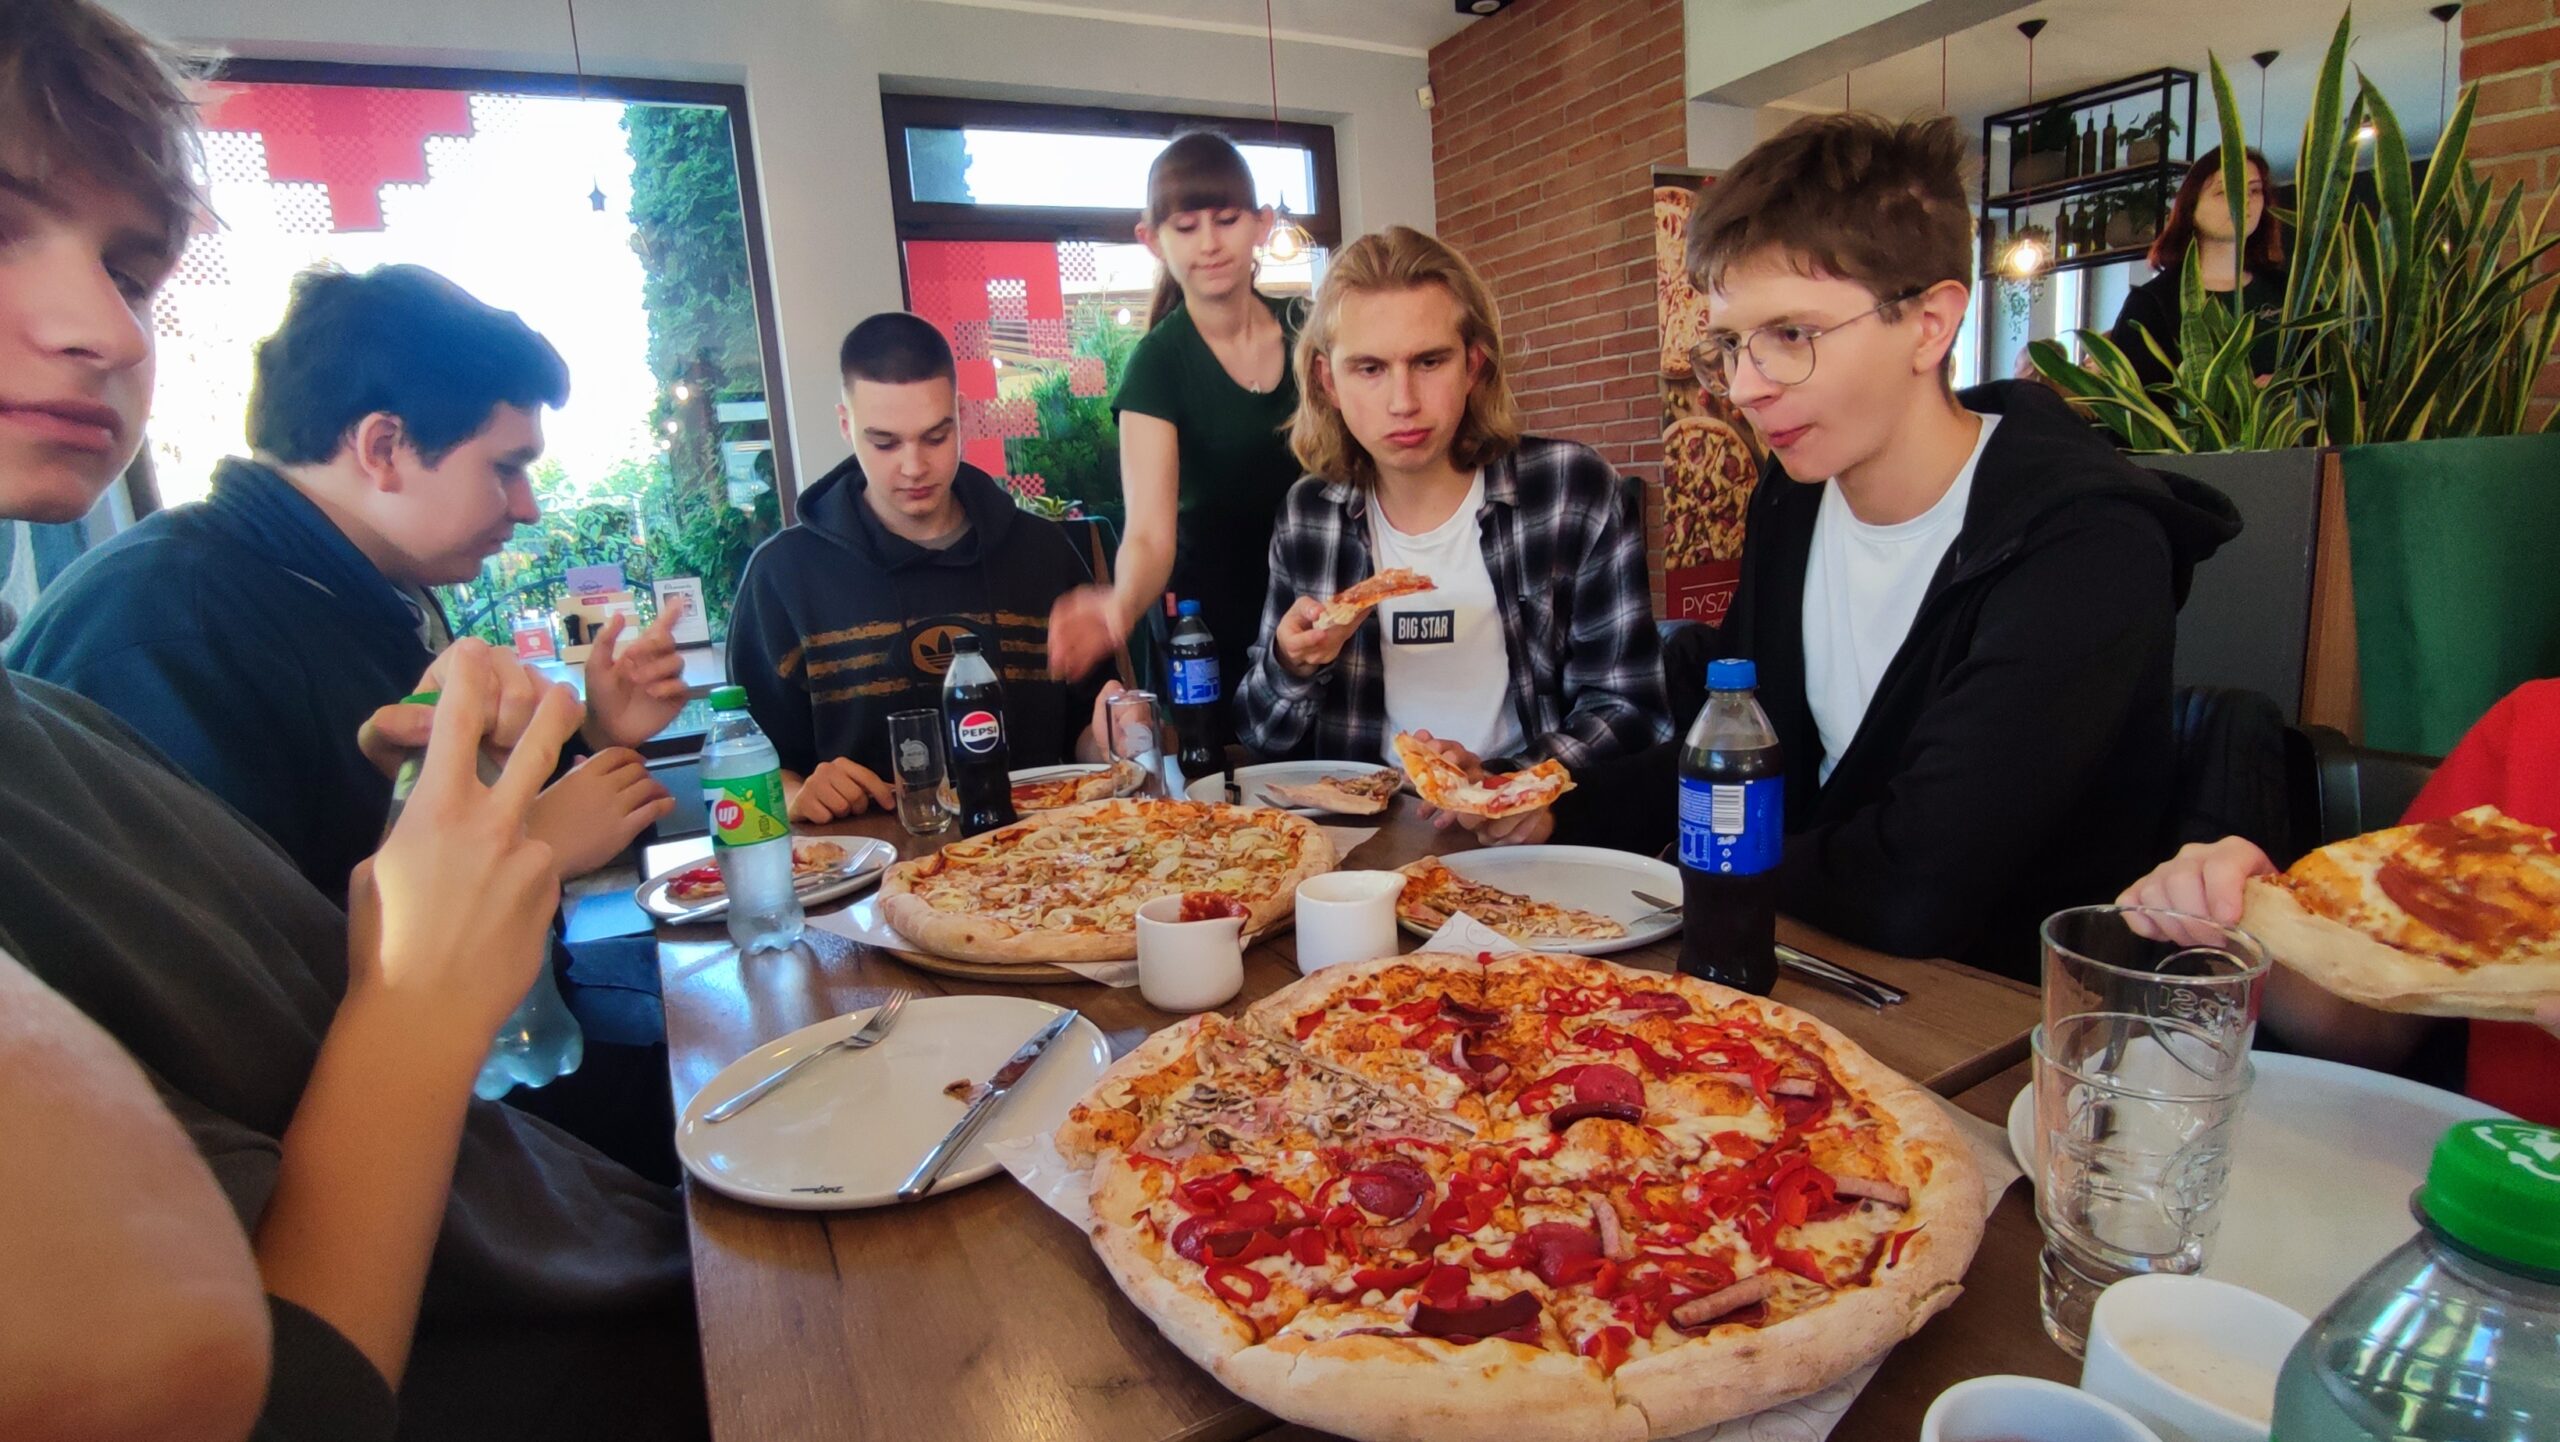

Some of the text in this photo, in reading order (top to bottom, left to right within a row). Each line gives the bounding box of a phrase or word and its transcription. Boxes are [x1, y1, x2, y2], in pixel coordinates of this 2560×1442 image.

[1398, 616, 1449, 640] BIG STAR
[962, 725, 997, 738] PEPSI
